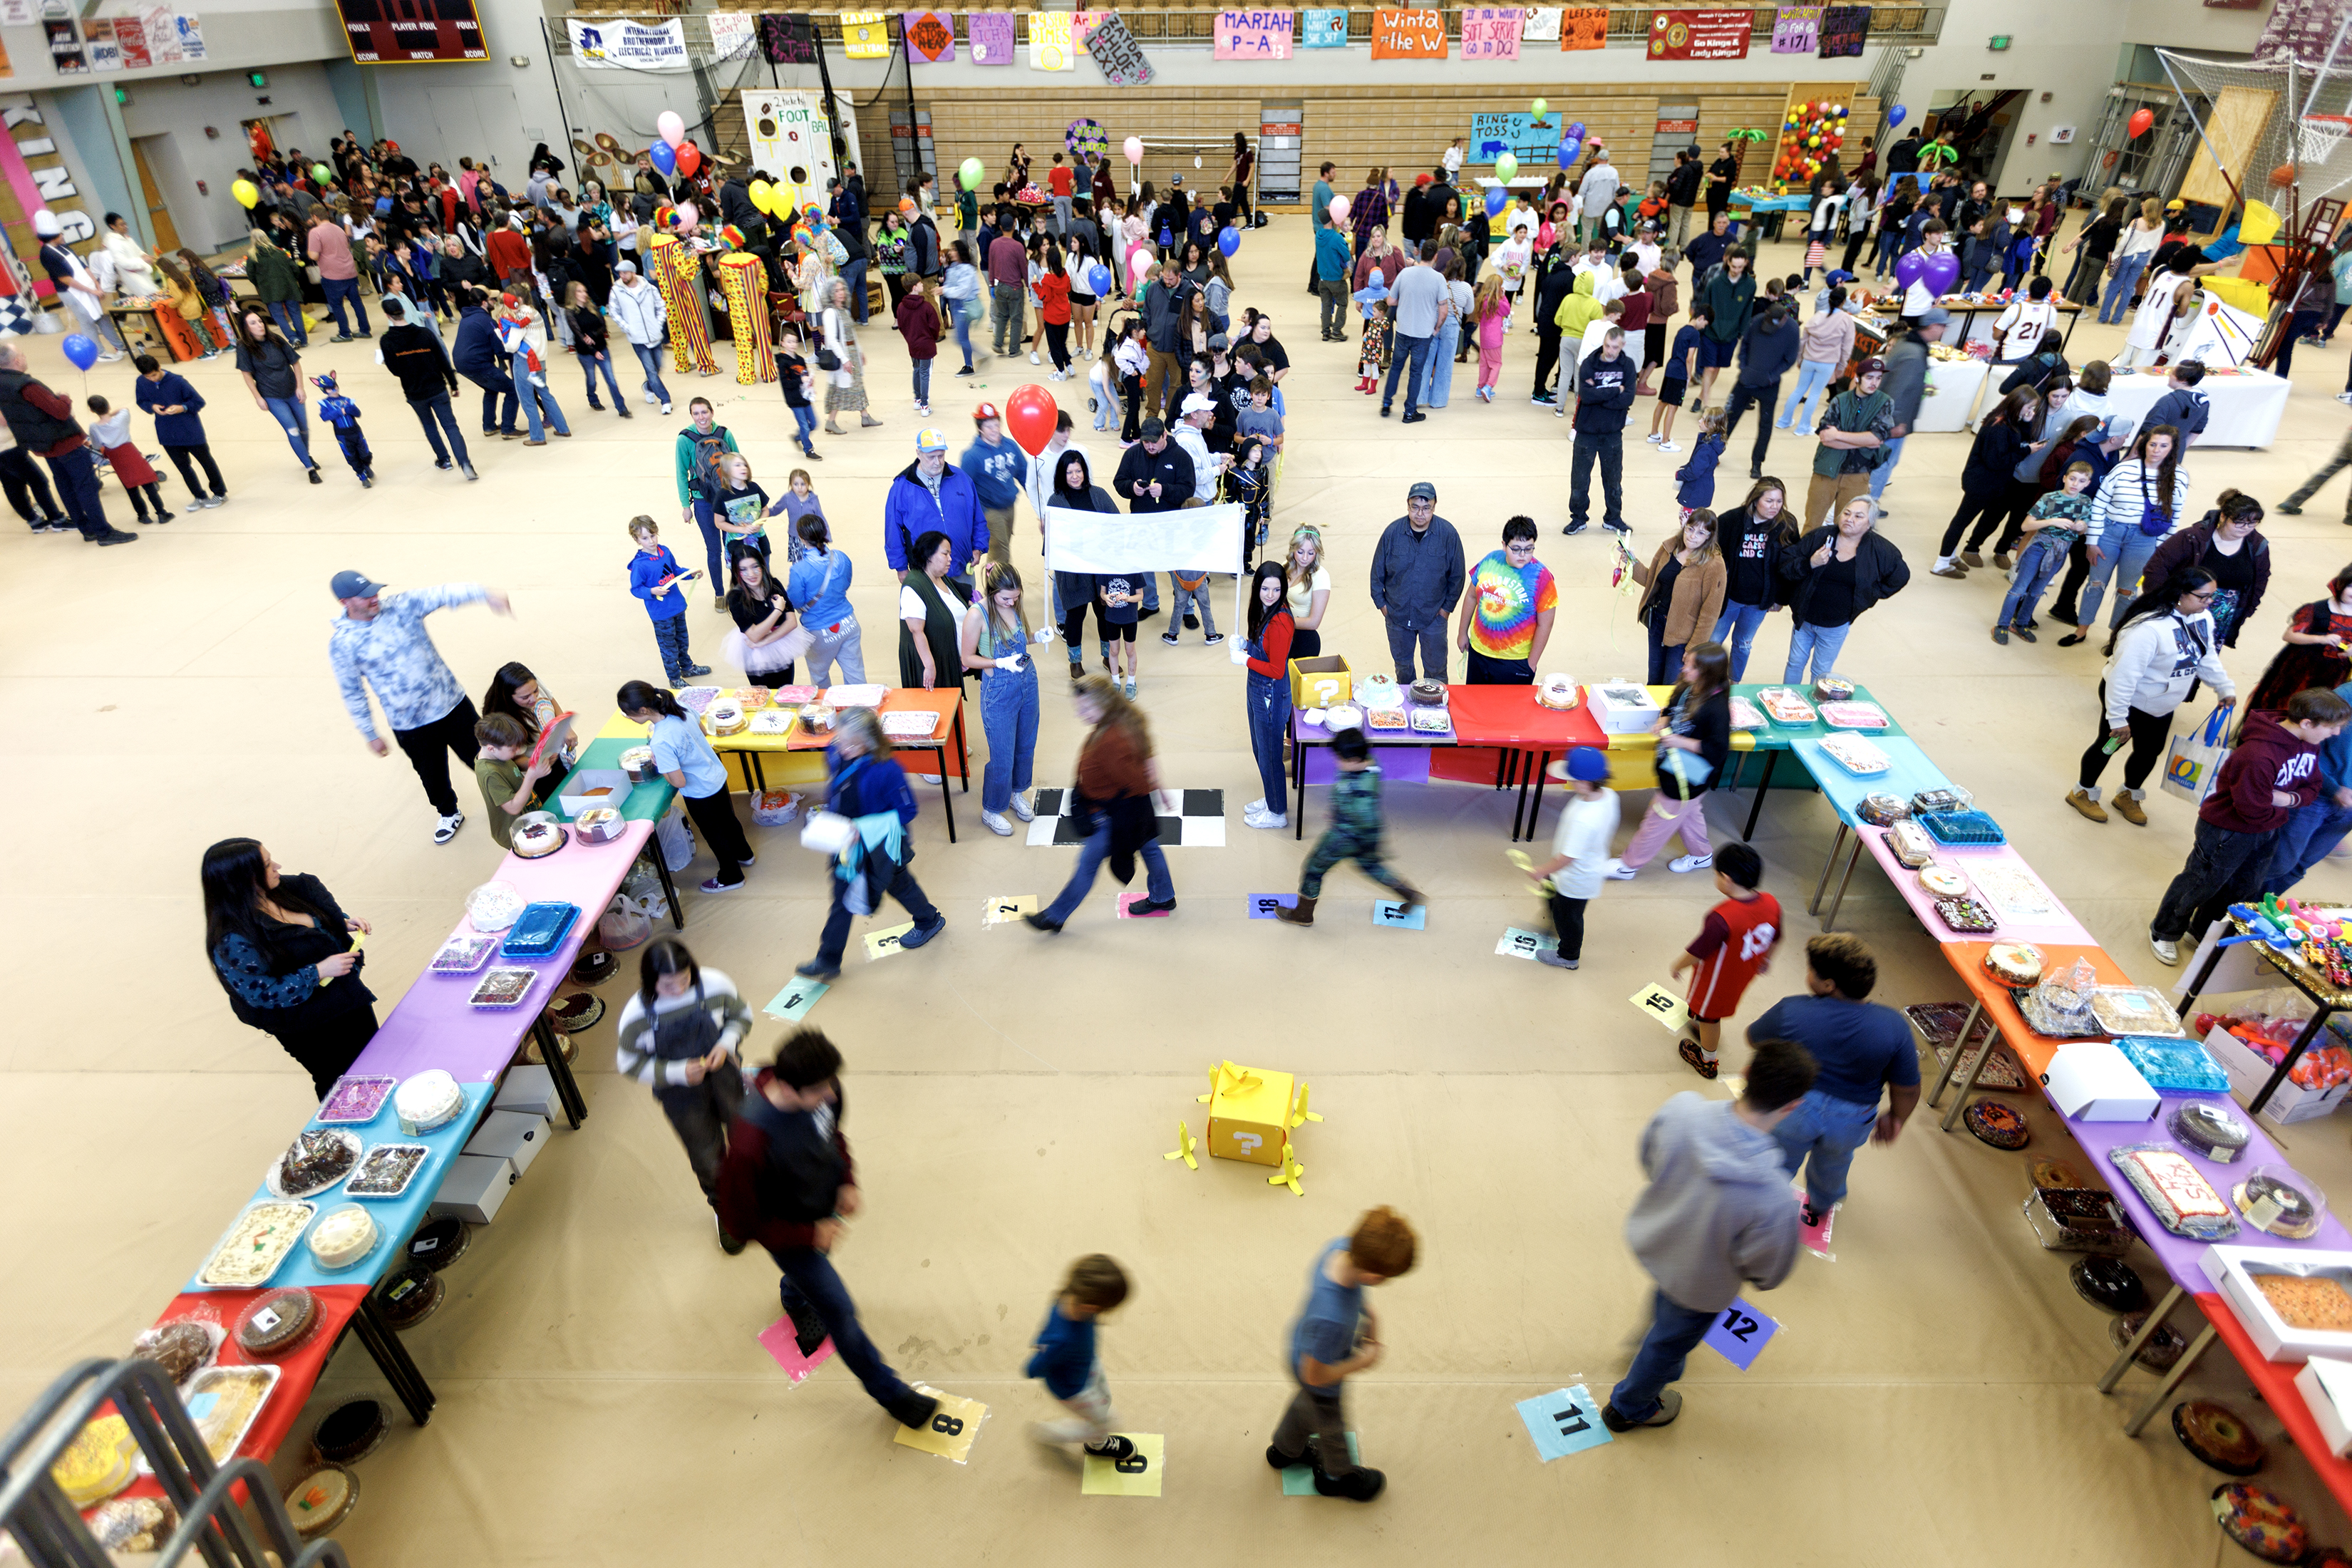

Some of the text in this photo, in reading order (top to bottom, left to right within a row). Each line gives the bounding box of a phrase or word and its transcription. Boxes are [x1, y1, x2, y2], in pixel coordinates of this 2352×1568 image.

[714, 15, 749, 26] IF YOU
[840, 13, 883, 25] KAYHI
[1029, 12, 1046, 28] #9
[1383, 10, 1439, 30] Winta
[1465, 9, 1523, 20] IF YOU WANT A
[1594, 9, 1606, 18] GO
[347, 21, 478, 32] FOULS PLAYER FOUL FOULS
[1225, 13, 1293, 31] MARIAH
[1307, 21, 1327, 32] WHAT
[1790, 21, 1805, 33] FOR
[624, 26, 670, 36] INTERNATIONAL
[713, 24, 739, 36] WANT
[910, 31, 948, 41] VICTORY
[1029, 27, 1071, 45] DIMES
[1462, 23, 1482, 42] SOFT
[1490, 21, 1517, 41] SERVE
[623, 36, 666, 46] BROTHERHOOD
[717, 34, 739, 47] SOFT
[918, 38, 946, 49] AHEAD
[1109, 16, 1143, 63] ZAYDA
[1389, 31, 1443, 51] the W
[1706, 38, 1731, 48] Kings
[618, 46, 684, 56] ELECTRICAL WORKERS
[1098, 26, 1135, 75] CHLOE
[1466, 40, 1512, 56] GO TO DQ
[1690, 48, 1740, 58] Lady Kings!
[356, 50, 486, 61] SCORE MATCH SCORE
[1086, 36, 1118, 78] LEXI
[774, 96, 805, 107] 2 tickets
[778, 109, 809, 123] FOOT
[1477, 114, 1508, 125] RING
[811, 120, 835, 133] BAL
[1074, 125, 1104, 138] SOCCER
[1475, 125, 1507, 138] TOSS
[2147, 288, 2167, 309] 11
[2017, 321, 2041, 339] 21
[179, 331, 192, 355] 3
[1478, 575, 1530, 604] YELLOWSTONE
[1482, 591, 1519, 607] NATIONAL PARK
[823, 619, 857, 644] BOYFRIEND
[999, 904, 1018, 913] 2
[1258, 899, 1279, 914] 18
[1384, 906, 1405, 920] 17
[877, 936, 899, 947] 3
[1514, 935, 1537, 952] 16
[783, 993, 804, 1009] 4
[1646, 992, 1674, 1013] 15
[1721, 1306, 1759, 1343] 12
[932, 1413, 964, 1436] 8
[1552, 1403, 1592, 1436] 11
